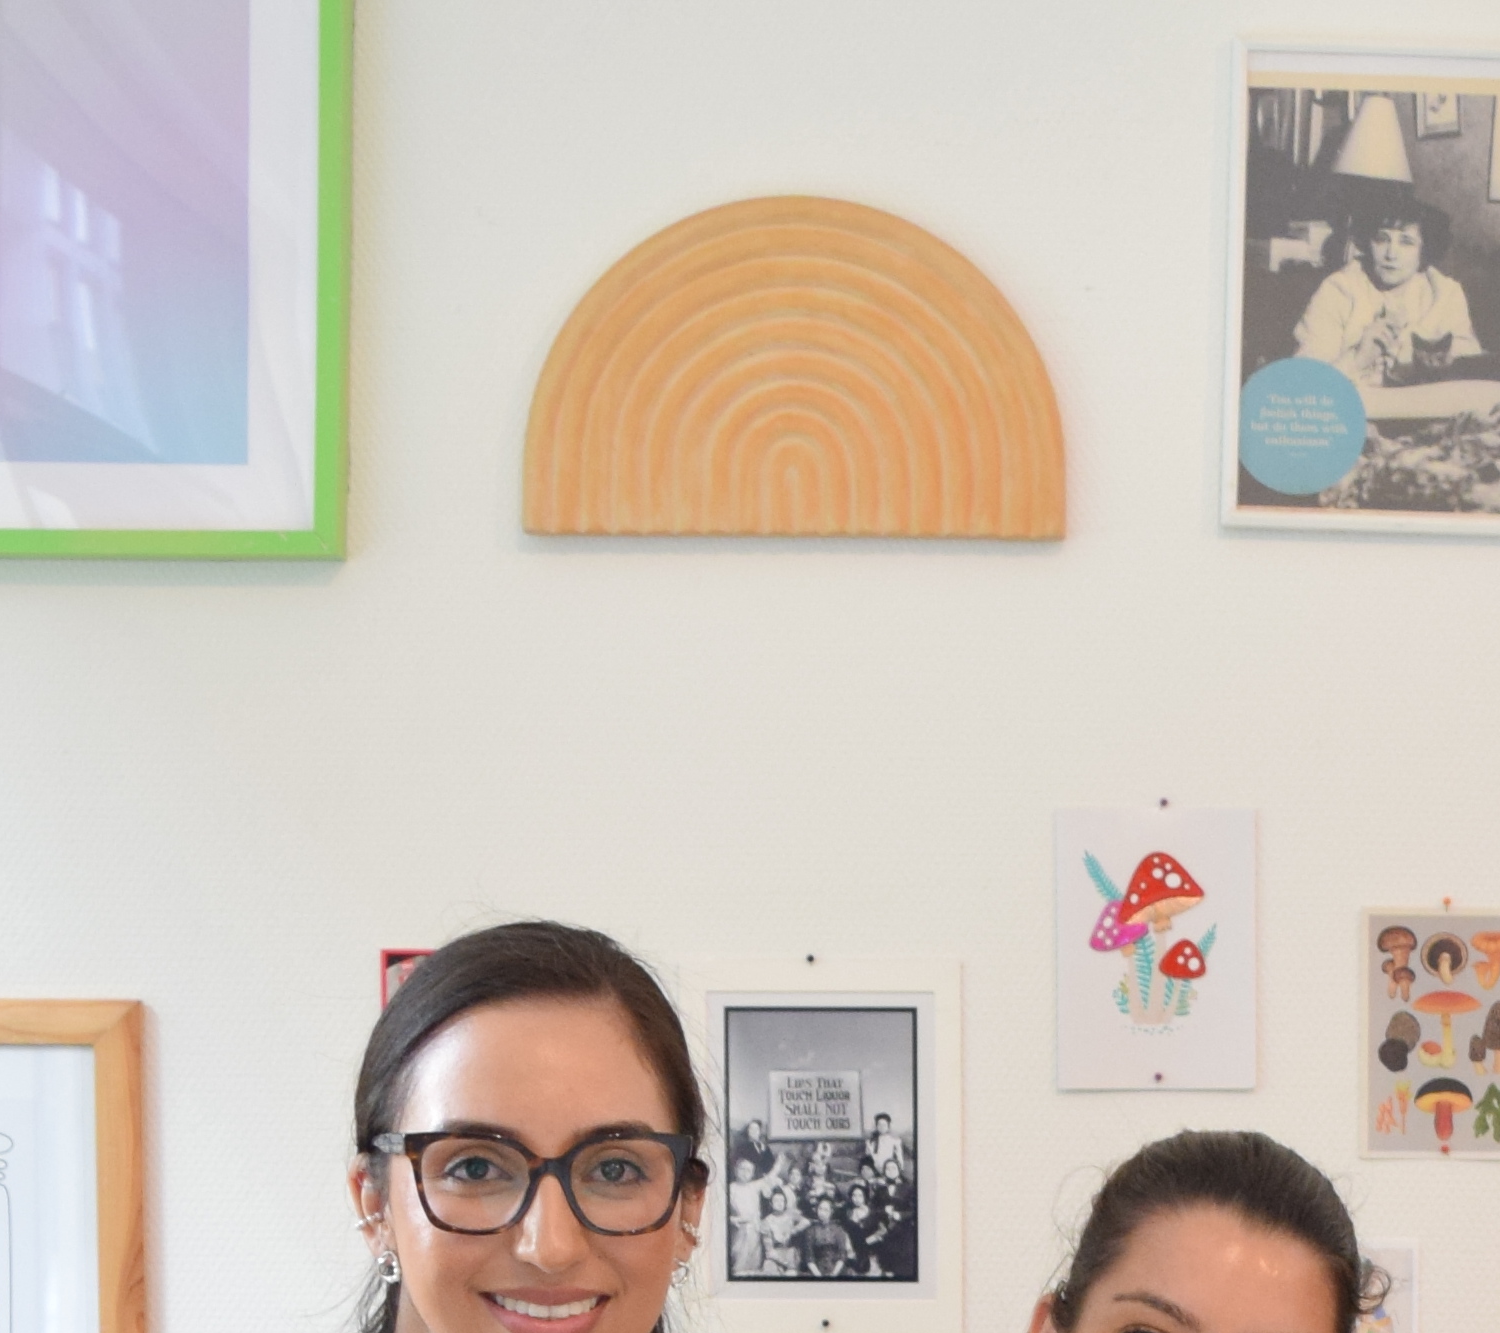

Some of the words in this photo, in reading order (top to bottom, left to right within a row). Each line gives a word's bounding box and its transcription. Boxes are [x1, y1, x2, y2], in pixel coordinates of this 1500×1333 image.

[785, 1103, 818, 1116] SHALL
[825, 1102, 848, 1115] NOT
[786, 1117, 820, 1131] TOUCH
